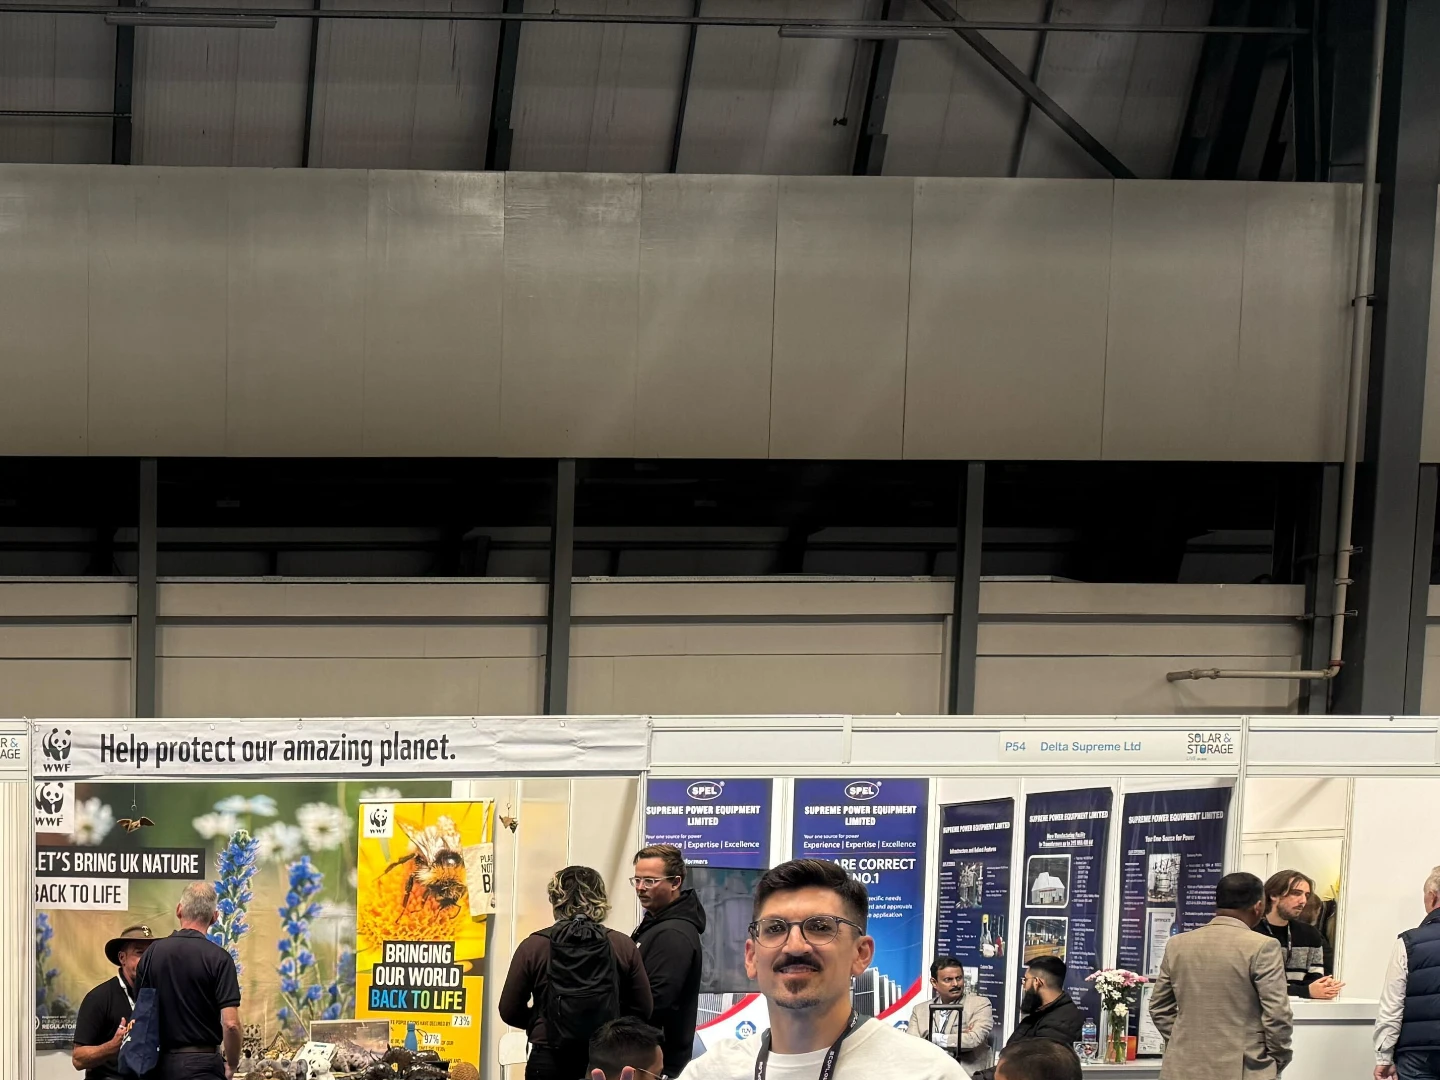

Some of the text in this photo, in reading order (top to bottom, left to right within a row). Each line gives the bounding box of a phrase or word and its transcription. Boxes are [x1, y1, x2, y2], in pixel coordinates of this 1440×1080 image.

[1188, 732, 1232, 743] SOLAR &
[10, 738, 18, 748] &
[1006, 741, 1142, 754] P54 Delta Supreme Ltd
[100, 731, 456, 768] Help protect our amazing planet.
[1187, 744, 1234, 754] STORAGE
[43, 764, 71, 772] WWF
[692, 786, 717, 795] SPEL
[850, 786, 874, 795] SPEL
[646, 806, 760, 815] SUPREME POWER EQUIPMENT
[804, 806, 918, 815] SUPREME POWER EQUIPMENT
[35, 817, 64, 826] WWF
[688, 817, 718, 826] LIMITED
[845, 817, 876, 826] LIMITED
[1170, 812, 1201, 822] EQUIPMENT
[1202, 811, 1223, 820] LIMITED
[688, 841, 719, 849] Expertise
[845, 841, 876, 849] Expertise
[35, 852, 199, 874] ET'S BRING UK NATURE
[859, 858, 916, 870] CORRECT
[852, 873, 879, 884] NO.1
[70, 884, 89, 904] TO
[93, 885, 122, 904] LIFE
[386, 944, 452, 964] BRINGING
[375, 966, 460, 987] OUR WORLD
[371, 989, 462, 1010] BACK TO LIFE
[454, 1016, 470, 1026] 73%
[424, 1034, 439, 1044] 97%
